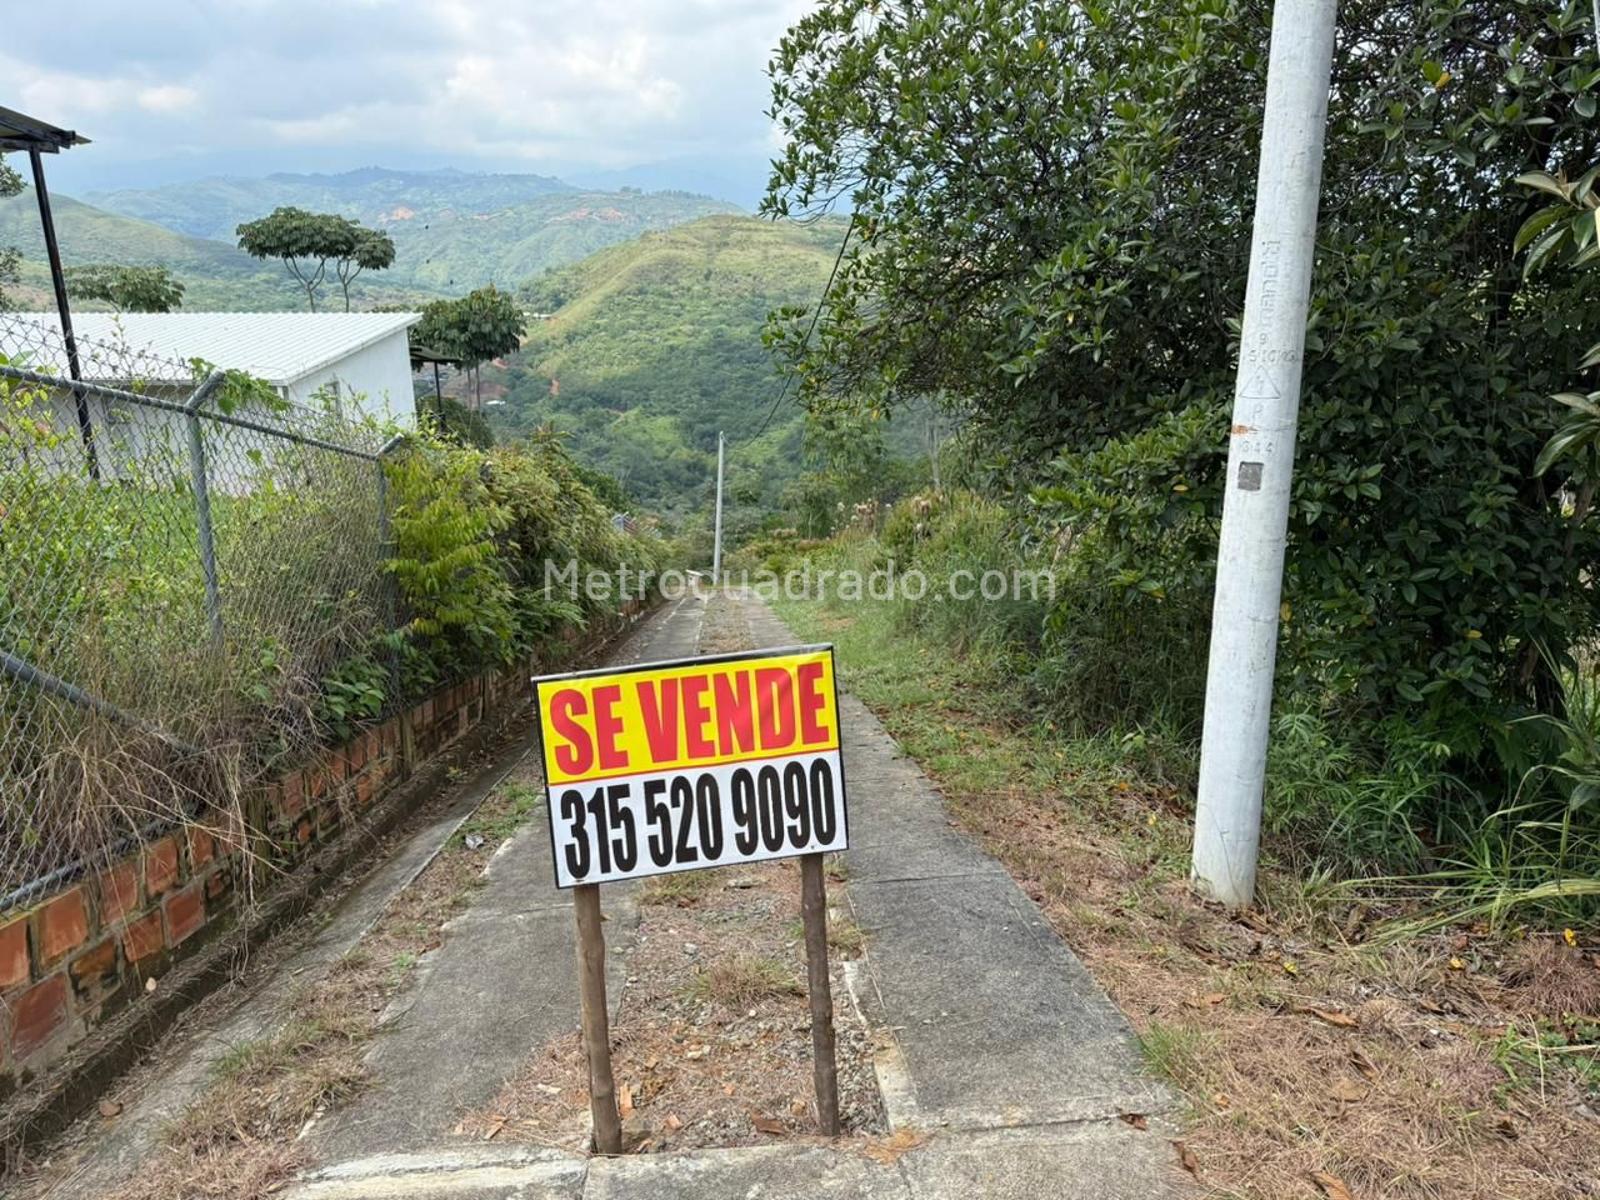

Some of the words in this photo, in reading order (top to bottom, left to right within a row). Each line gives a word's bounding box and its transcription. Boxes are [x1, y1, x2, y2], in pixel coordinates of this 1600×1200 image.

[549, 684, 630, 776] SE
[635, 662, 830, 763] VENDE
[560, 783, 638, 879] 315
[644, 773, 723, 867] 520
[730, 758, 836, 856] 9090
